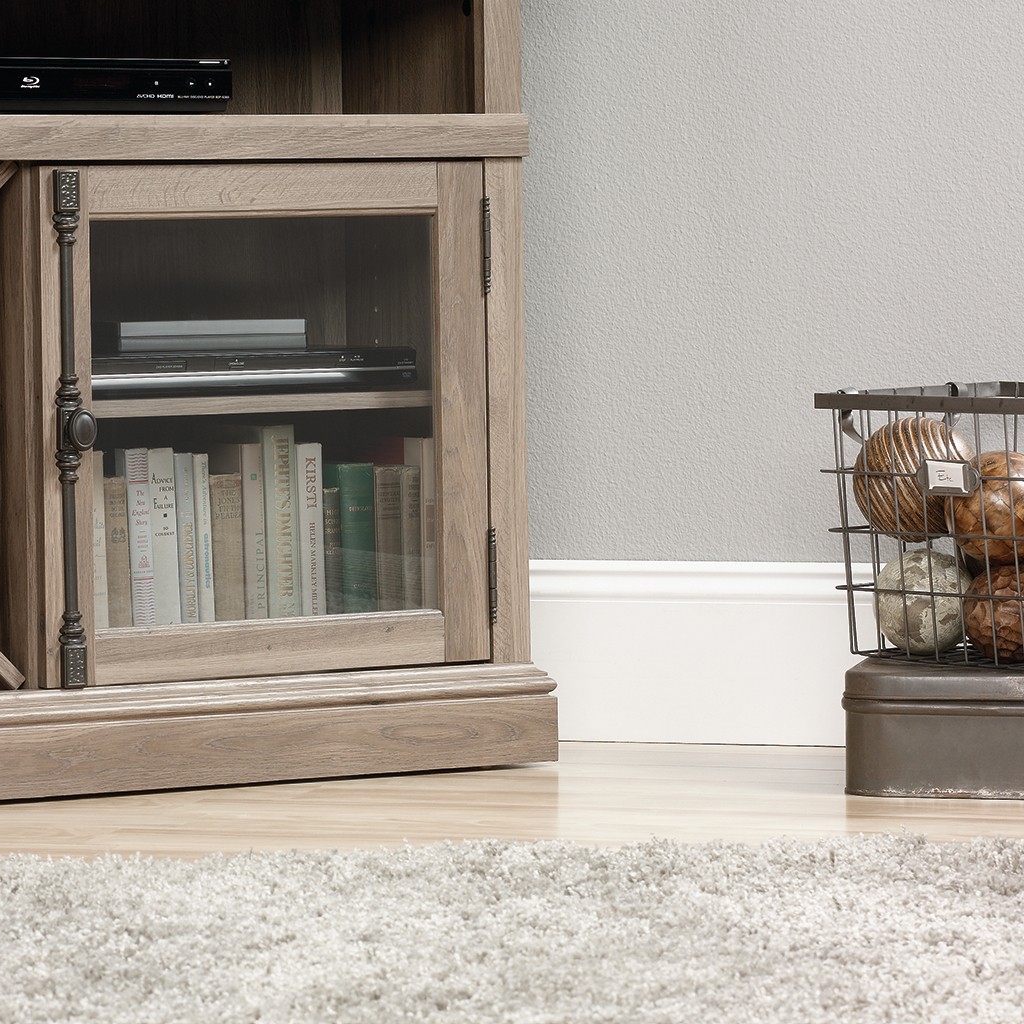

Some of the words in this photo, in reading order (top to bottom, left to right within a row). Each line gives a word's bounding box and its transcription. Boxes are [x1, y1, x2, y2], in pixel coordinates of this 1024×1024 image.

[217, 497, 240, 506] JONES
[305, 456, 318, 509] KIRSTI
[203, 532, 212, 589] astronautics
[274, 512, 294, 598] DAUGHTER
[309, 522, 317, 549] HELEN
[255, 528, 266, 610] PRINCIPAL
[310, 549, 318, 588] MARKLEY
